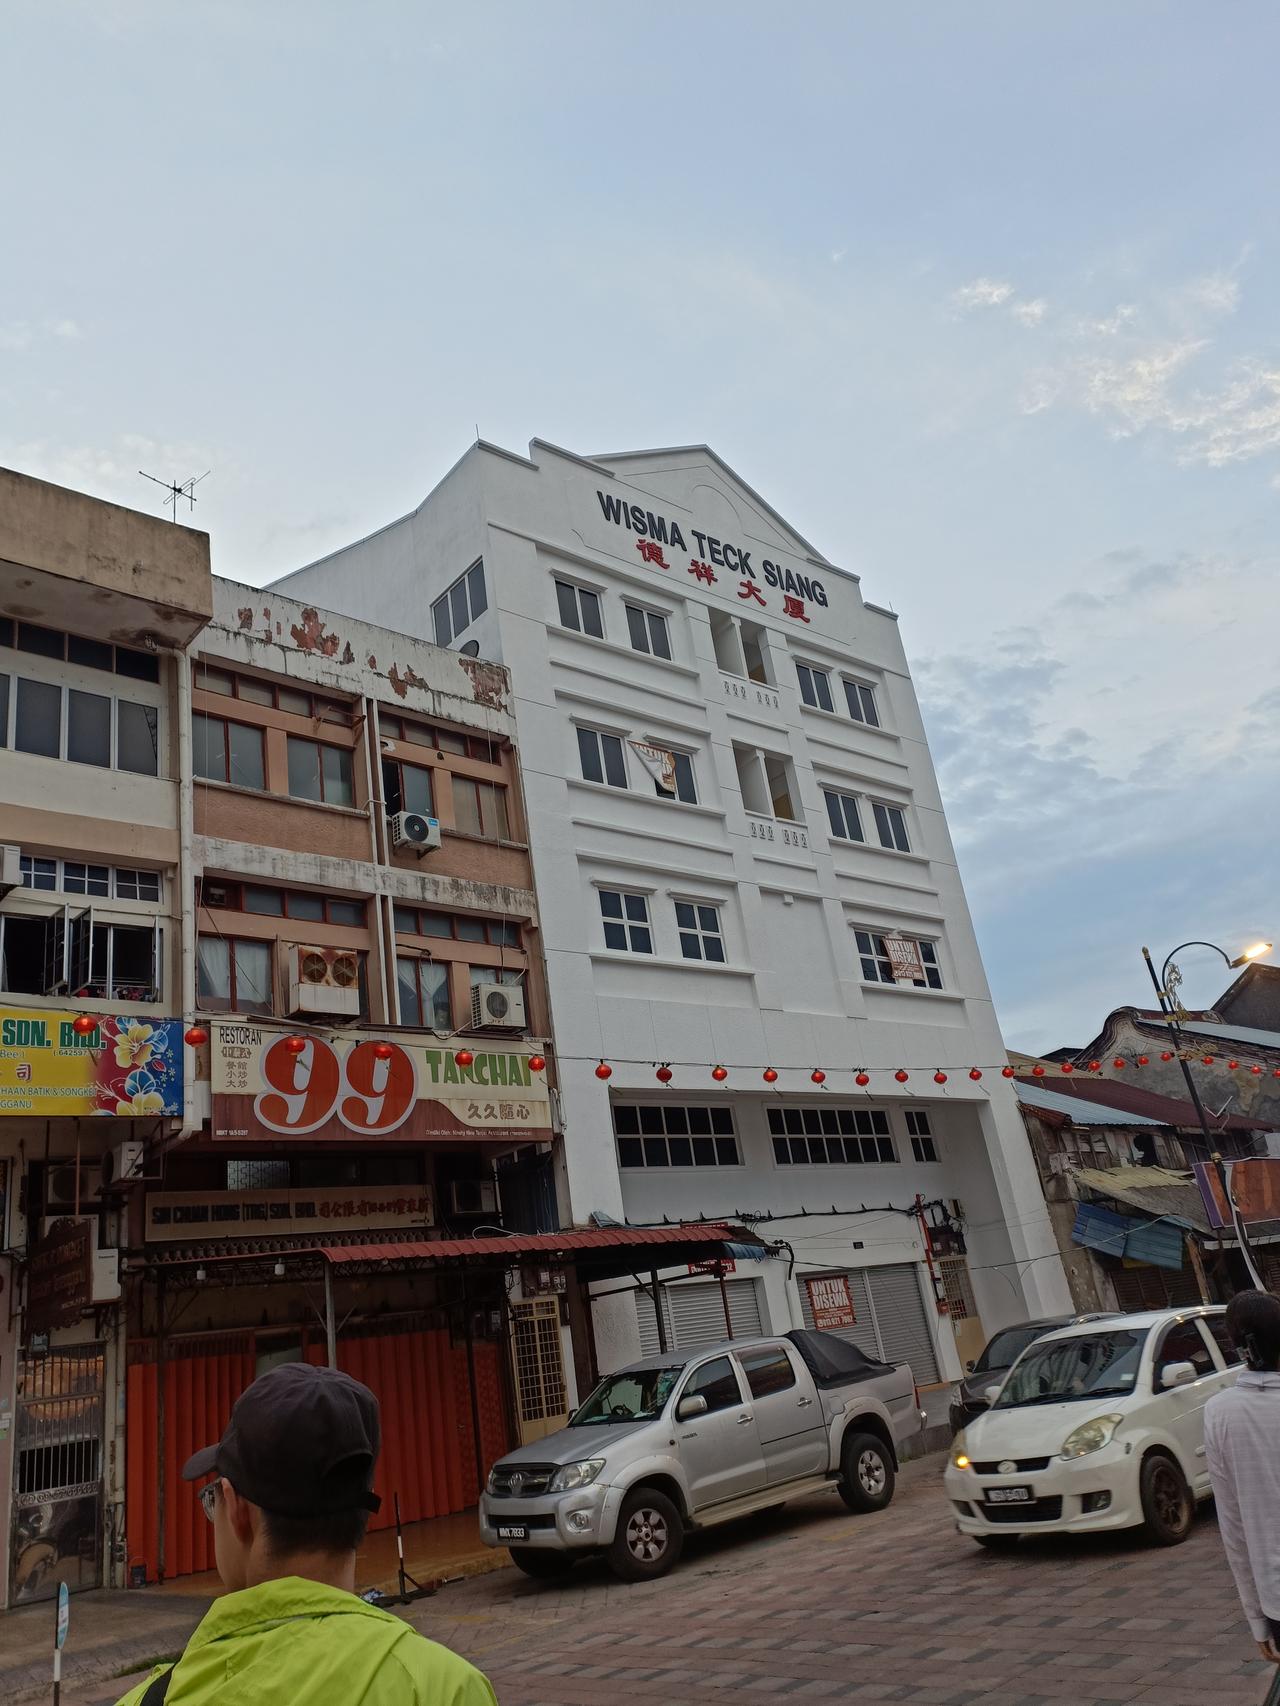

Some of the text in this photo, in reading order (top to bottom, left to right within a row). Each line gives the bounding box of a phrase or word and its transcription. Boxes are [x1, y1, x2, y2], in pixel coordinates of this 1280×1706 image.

[597, 490, 829, 608] WISMA TECK SIANG
[2, 1018, 52, 1047] SDN.
[219, 1026, 262, 1046] RESTORAN
[28, 1087, 51, 1097] BATIK
[52, 1087, 59, 1097] &
[59, 1087, 97, 1097] SONGKET
[225, 1079, 248, 1089] 大炒
[255, 1033, 417, 1134] 99
[811, 1278, 846, 1295] UNTUK
[813, 1292, 850, 1310] DISEWA
